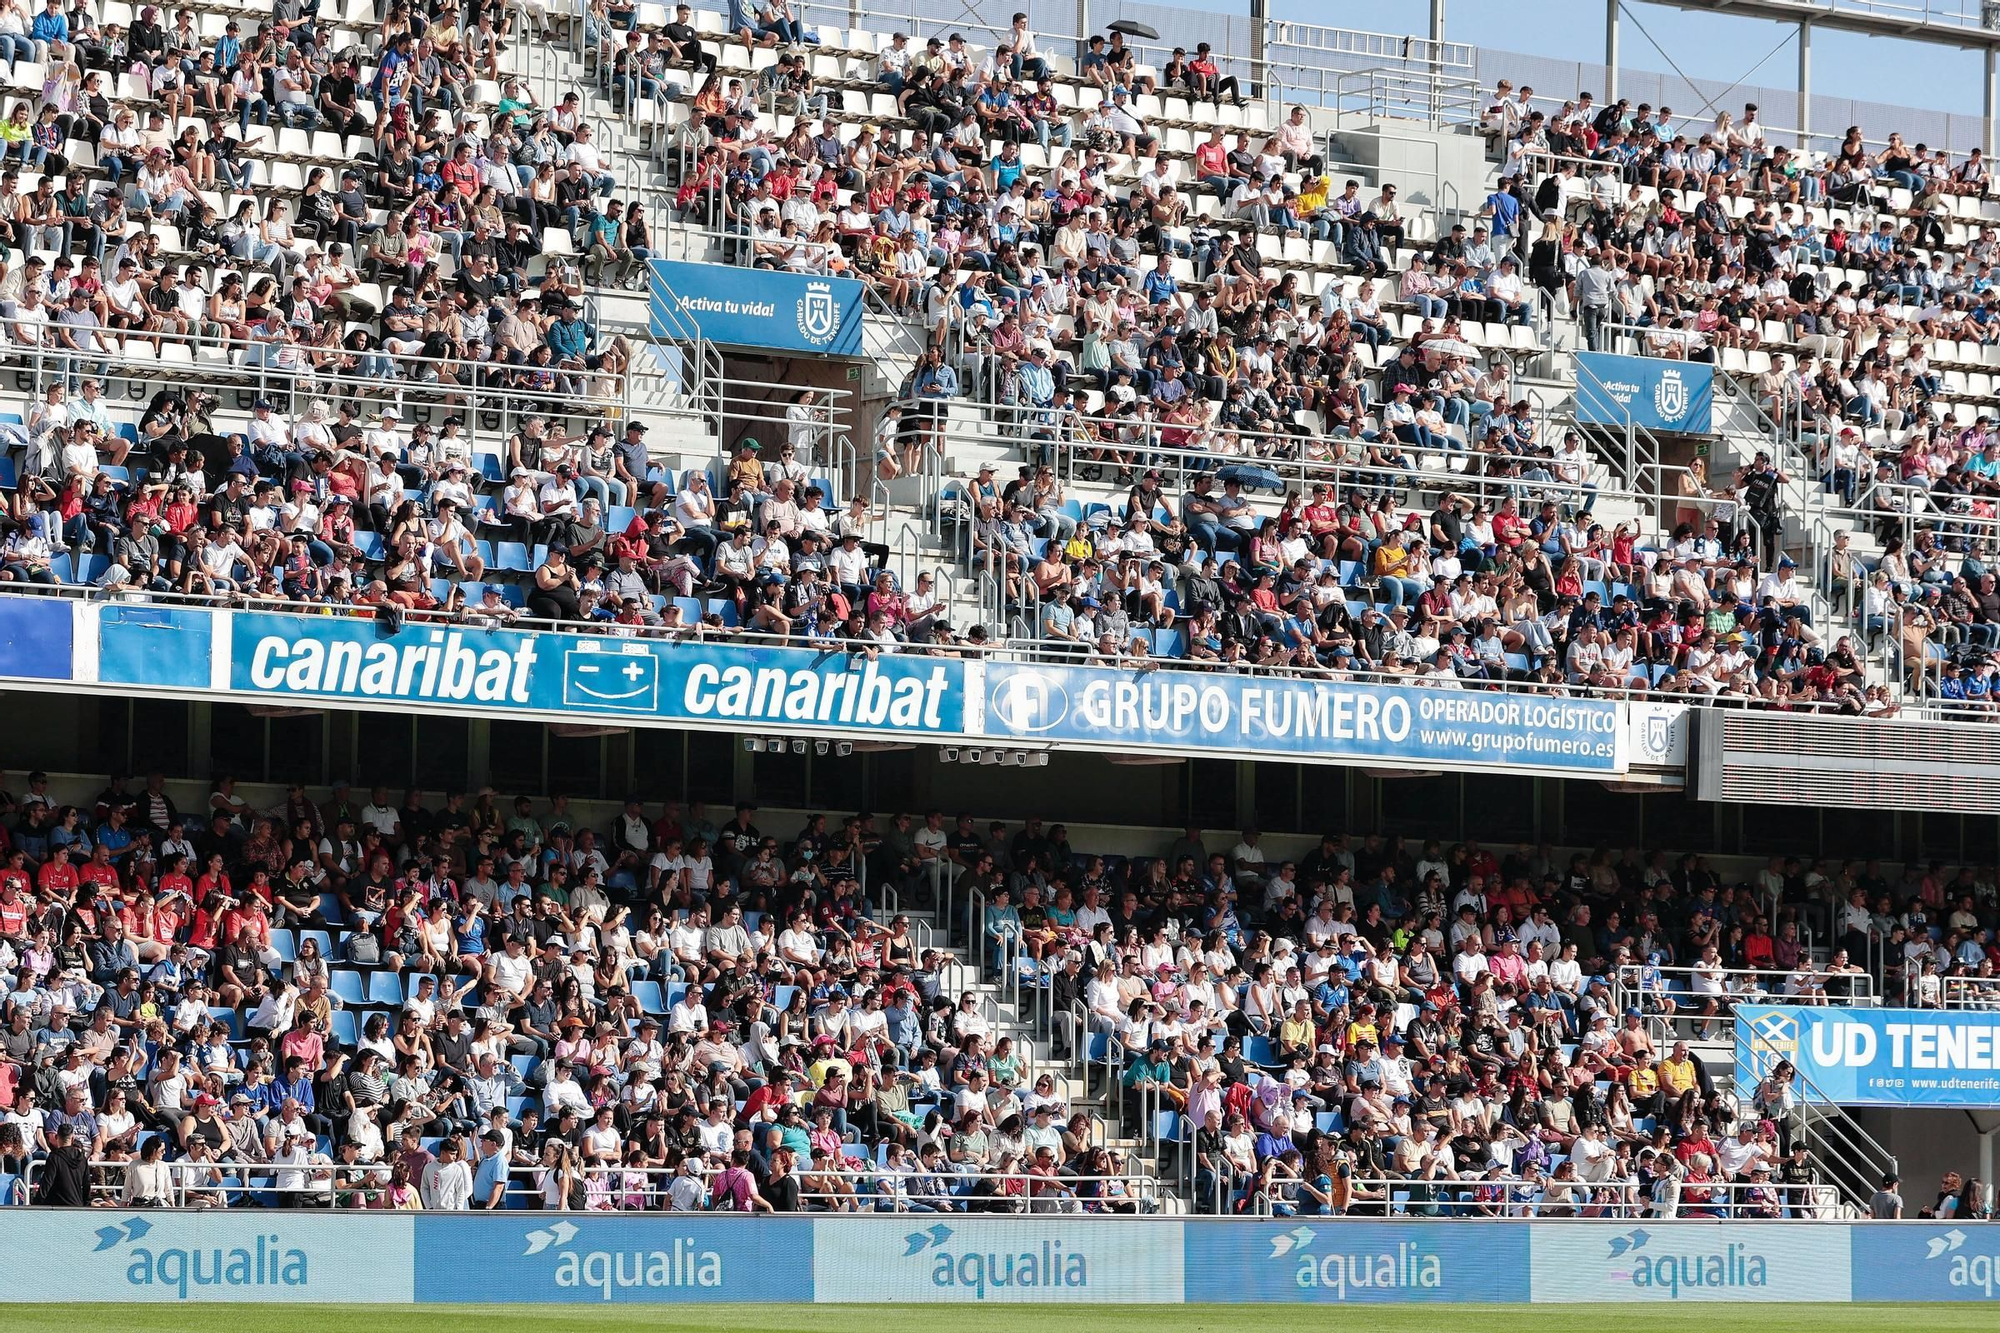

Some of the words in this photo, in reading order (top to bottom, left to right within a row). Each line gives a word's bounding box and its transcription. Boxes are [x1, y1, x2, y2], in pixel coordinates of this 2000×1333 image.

[675, 295, 722, 313] ¡Activa
[724, 300, 739, 314] tu
[741, 301, 775, 318] vida!
[810, 335, 822, 346] DE
[821, 302, 841, 345] TENERIFE
[1630, 383, 1640, 393] tu
[250, 630, 538, 704] canaribat
[684, 660, 949, 729] canaribat
[1081, 679, 1230, 734] GRUPO
[1241, 688, 1412, 743] FUMERO
[1419, 697, 1520, 726] OPERADOR
[1524, 703, 1616, 734] LOGÍSTICO
[1419, 728, 1615, 759] www.grupofumero.es
[1811, 1021, 1877, 1068] UD
[1911, 1076, 1999, 1090] www.udtenerife
[126, 1234, 308, 1299] aqualia
[554, 1237, 723, 1300] aqualia
[931, 1239, 1087, 1300] aqualia
[1296, 1241, 1441, 1300] aqualia
[1631, 1242, 1767, 1300] aqualia
